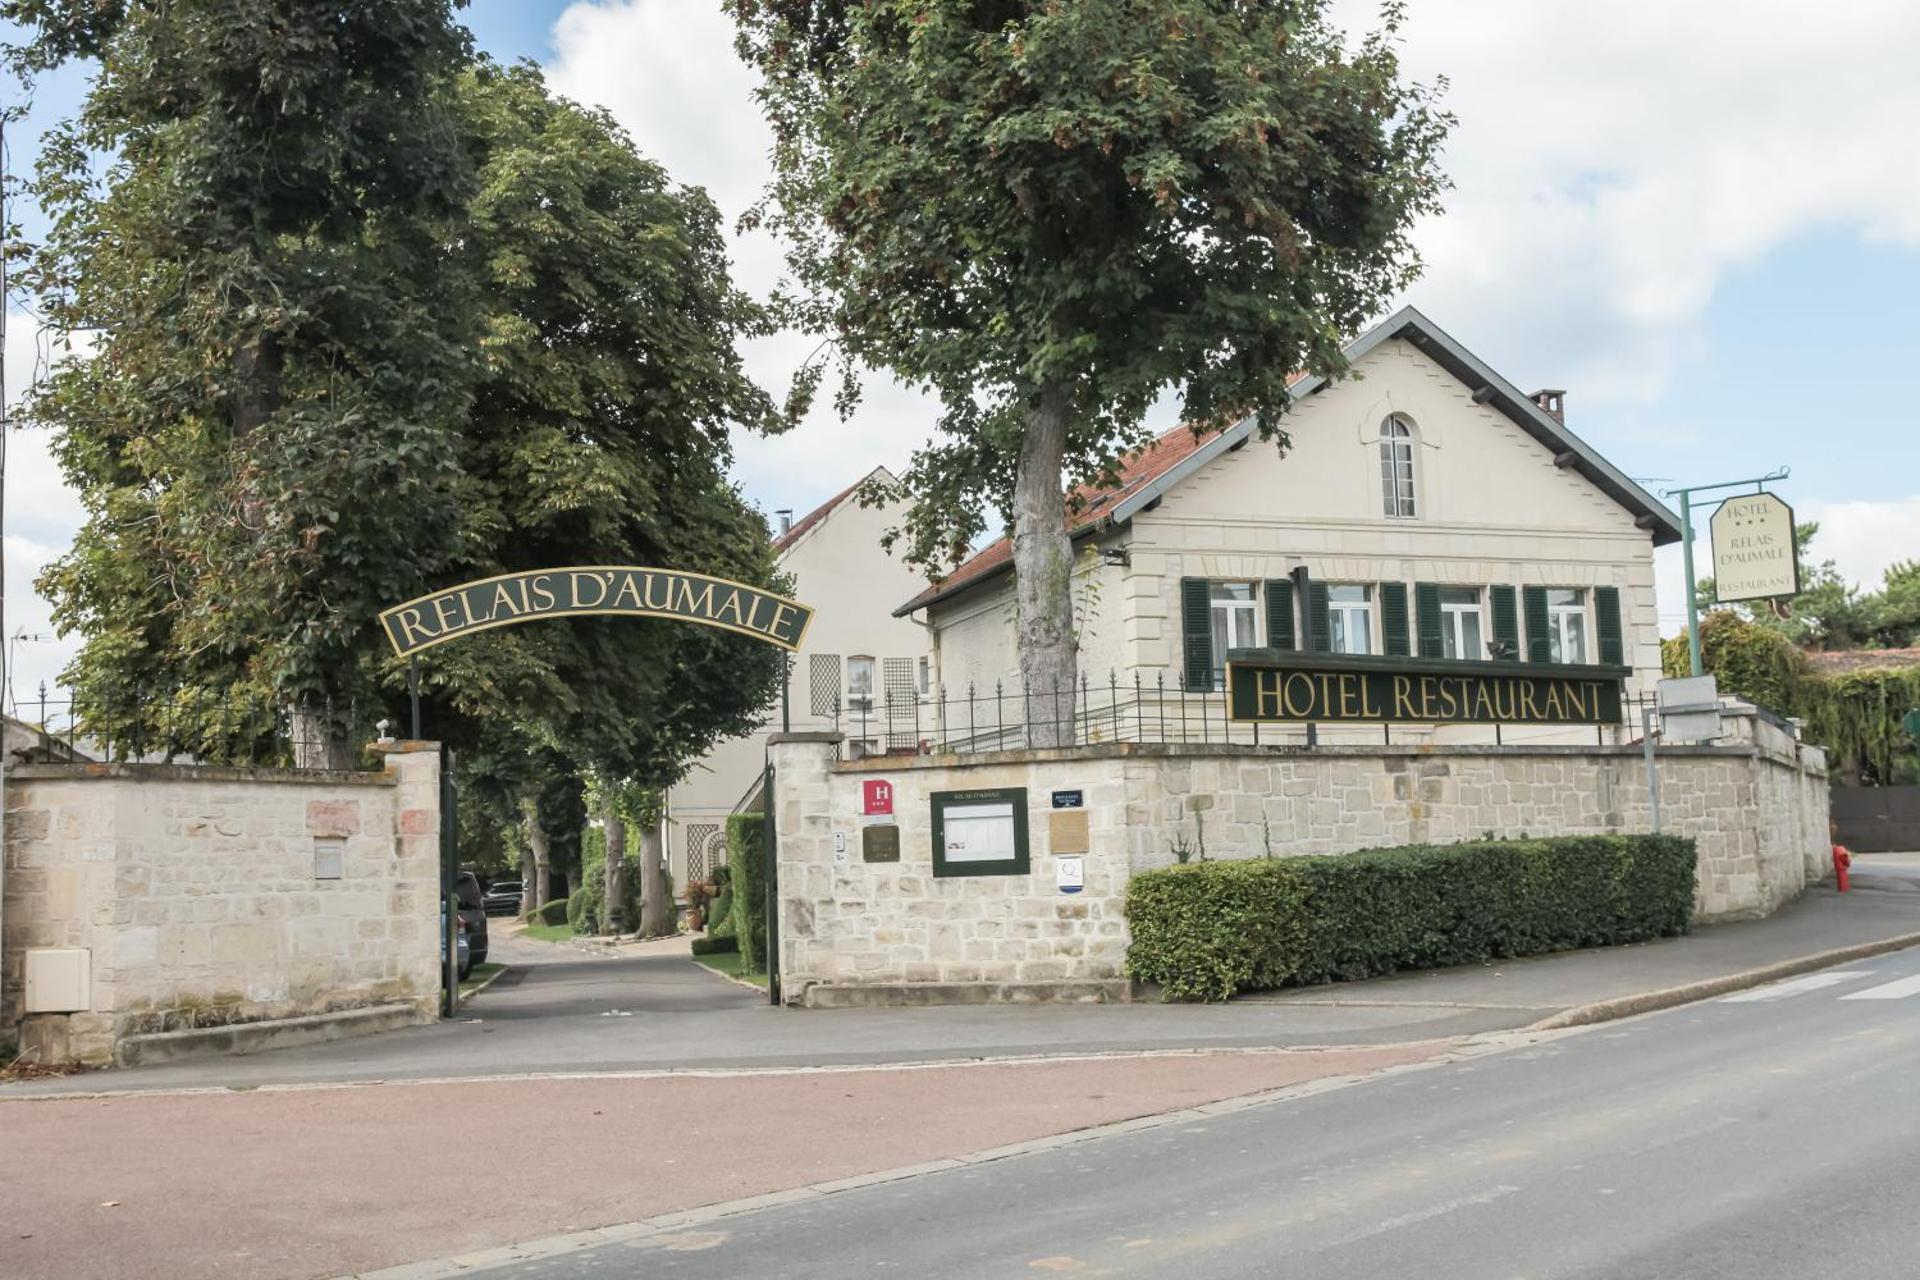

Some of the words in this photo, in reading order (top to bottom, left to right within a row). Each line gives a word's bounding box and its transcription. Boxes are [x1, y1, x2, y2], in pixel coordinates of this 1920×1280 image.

[1731, 534, 1775, 550] RELAIS
[394, 575, 556, 647] RELAIS
[570, 572, 798, 641] D'AUMALE
[1255, 671, 1381, 718] HOTEL
[1393, 675, 1604, 720] RESTAURANT
[876, 786, 889, 800] H
